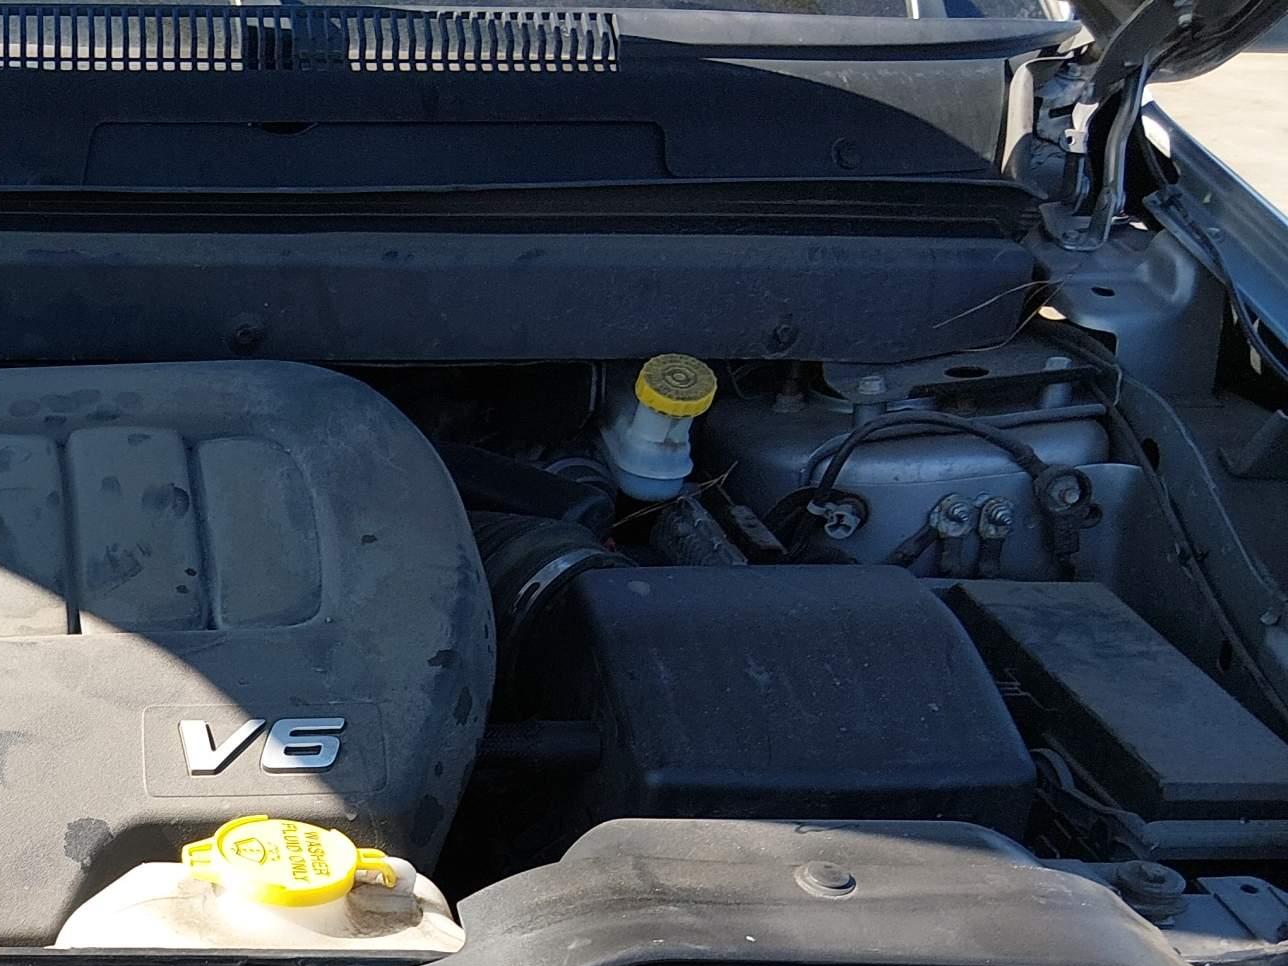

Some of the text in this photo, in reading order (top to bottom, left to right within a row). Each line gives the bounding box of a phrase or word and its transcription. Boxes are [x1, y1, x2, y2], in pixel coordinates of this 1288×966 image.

[178, 718, 345, 776] V6
[281, 822, 310, 884] FLUID ONLY
[304, 831, 331, 877] WASHER
